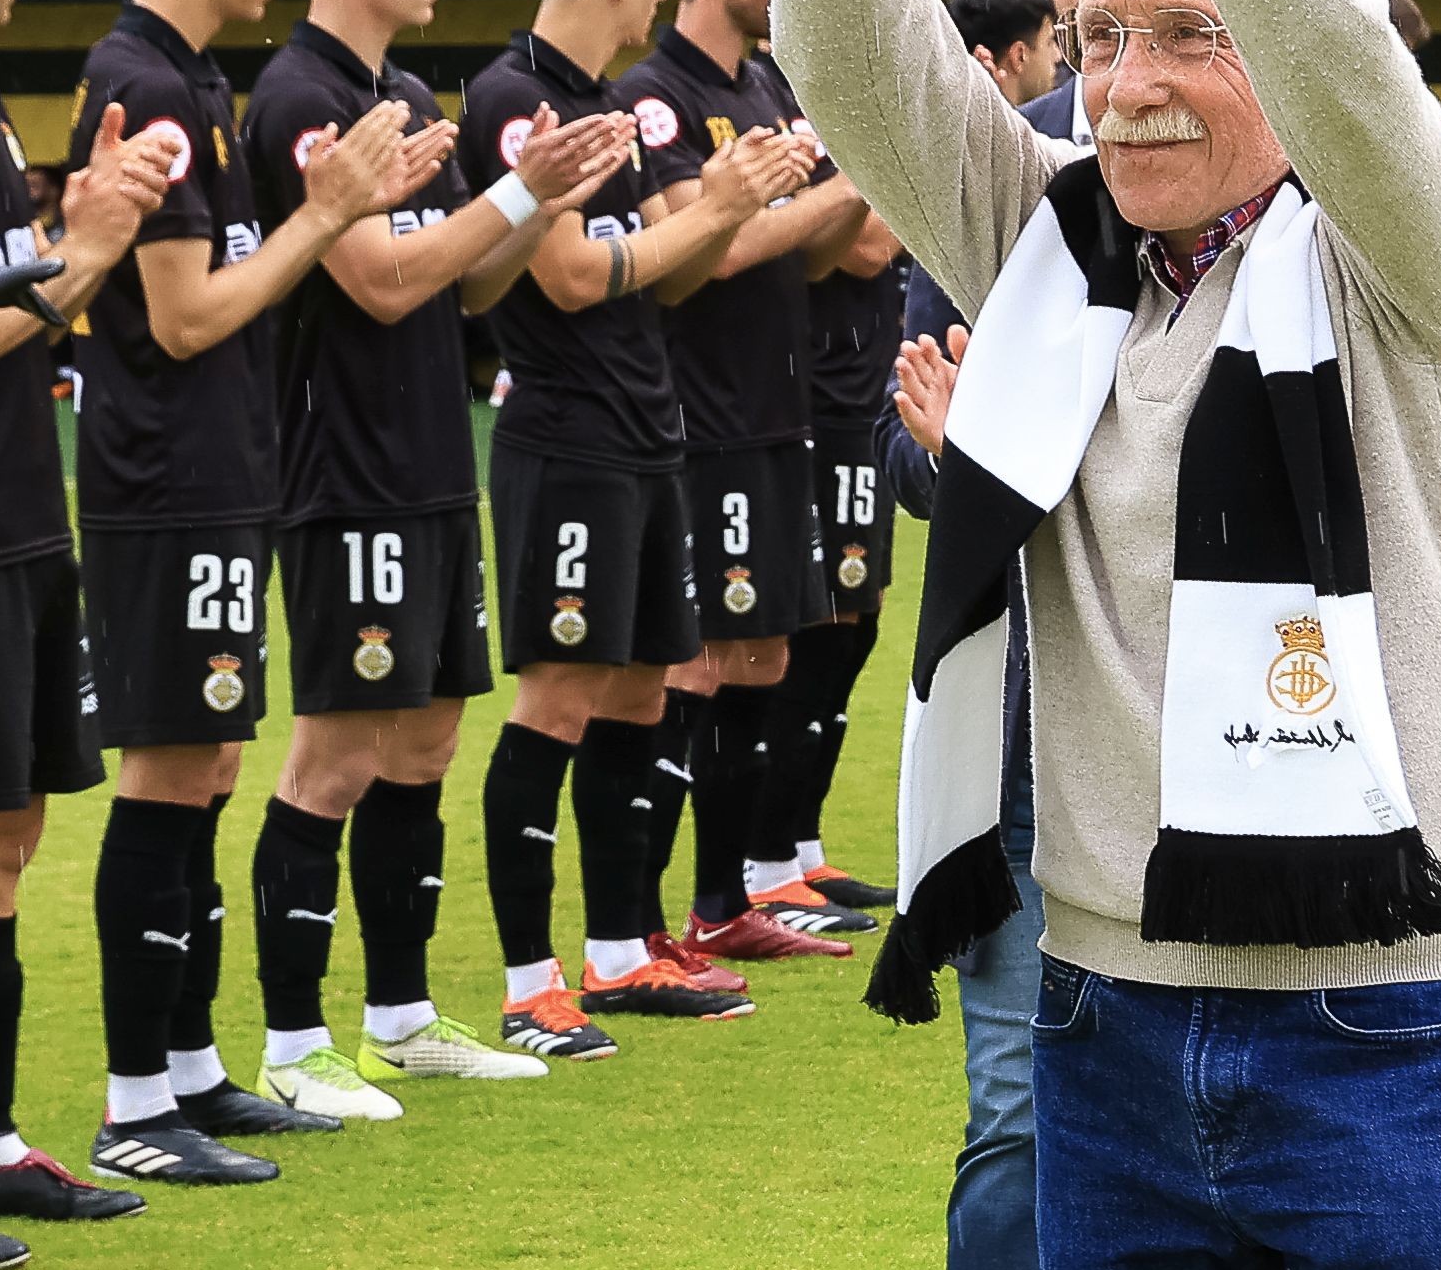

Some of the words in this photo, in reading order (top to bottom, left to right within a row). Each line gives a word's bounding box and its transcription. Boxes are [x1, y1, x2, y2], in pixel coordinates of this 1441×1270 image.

[722, 492, 750, 555] 3
[835, 464, 876, 525] 15
[342, 531, 404, 604] 16
[555, 522, 589, 589] 2
[186, 553, 254, 634] 23
